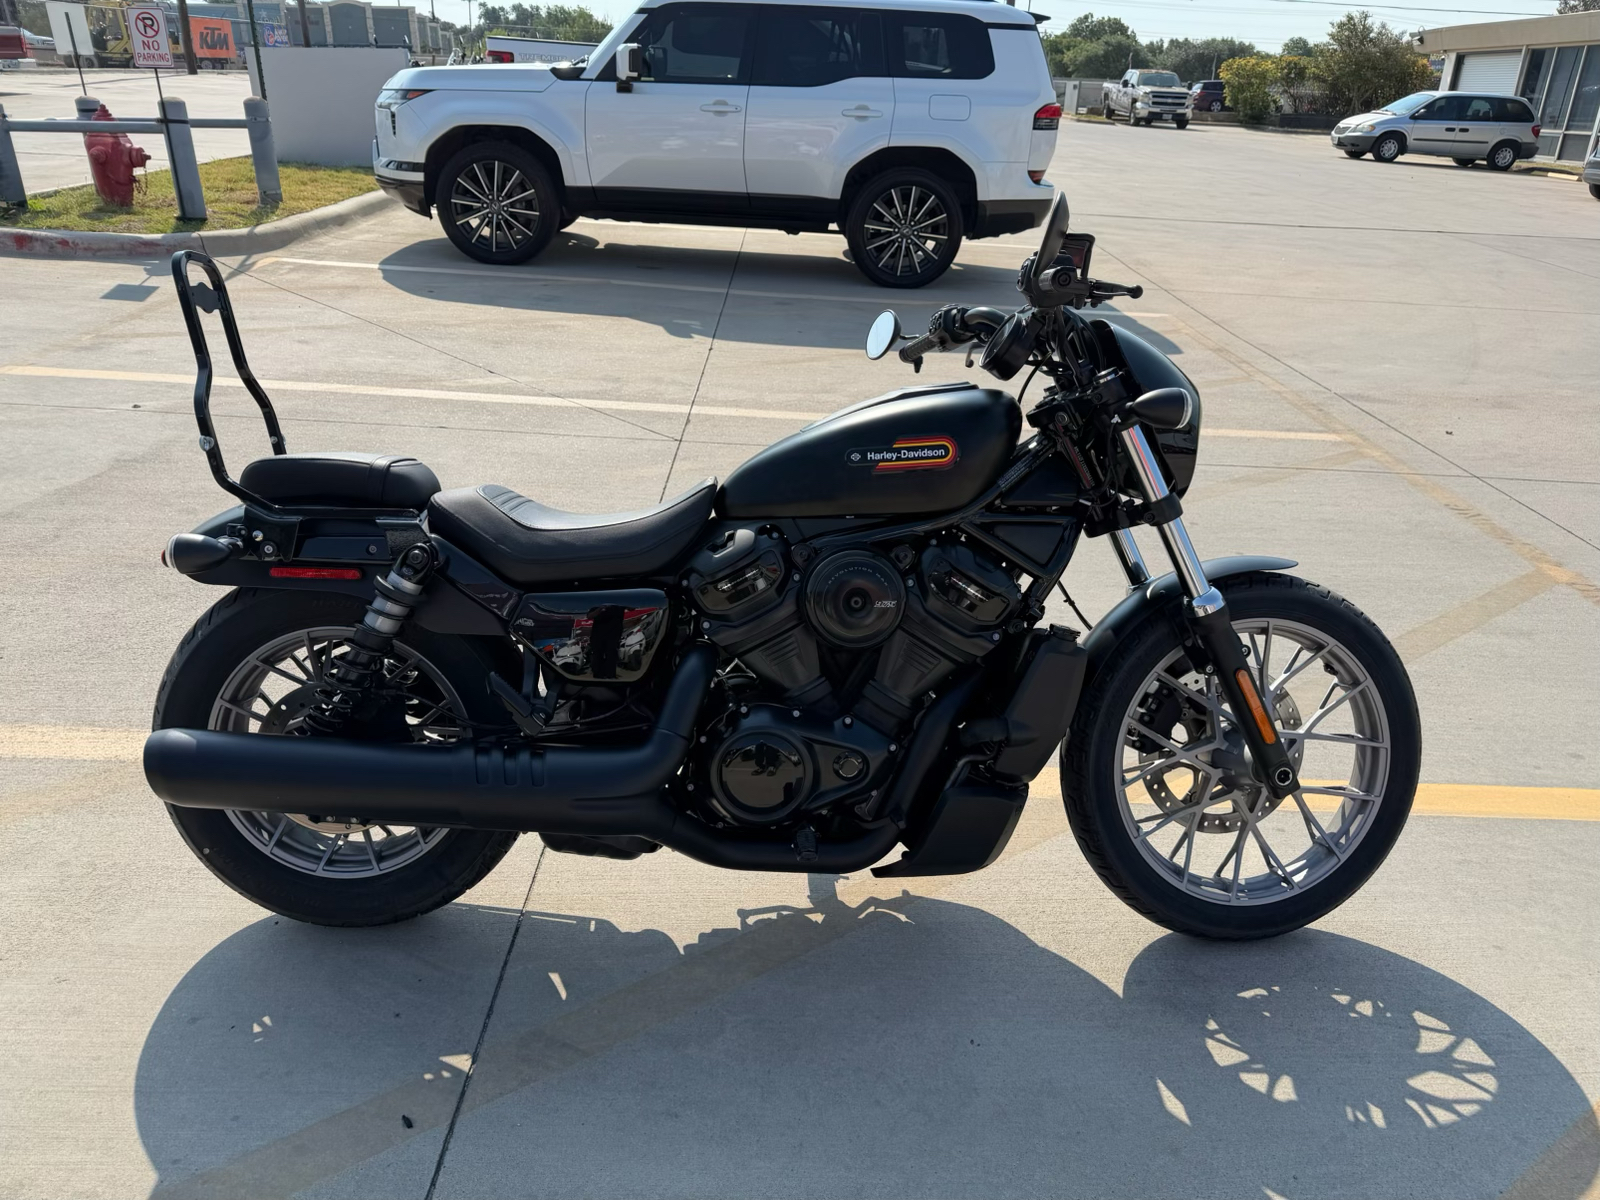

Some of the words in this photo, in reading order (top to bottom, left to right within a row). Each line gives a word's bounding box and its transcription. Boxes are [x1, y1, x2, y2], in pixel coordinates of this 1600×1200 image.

[199, 27, 229, 50] KTM
[142, 40, 160, 51] NO
[137, 52, 169, 62] PARKING
[519, 53, 567, 61] TREMOR
[867, 448, 945, 461] Harley-Davidson
[828, 566, 873, 585] REVOLUTION
